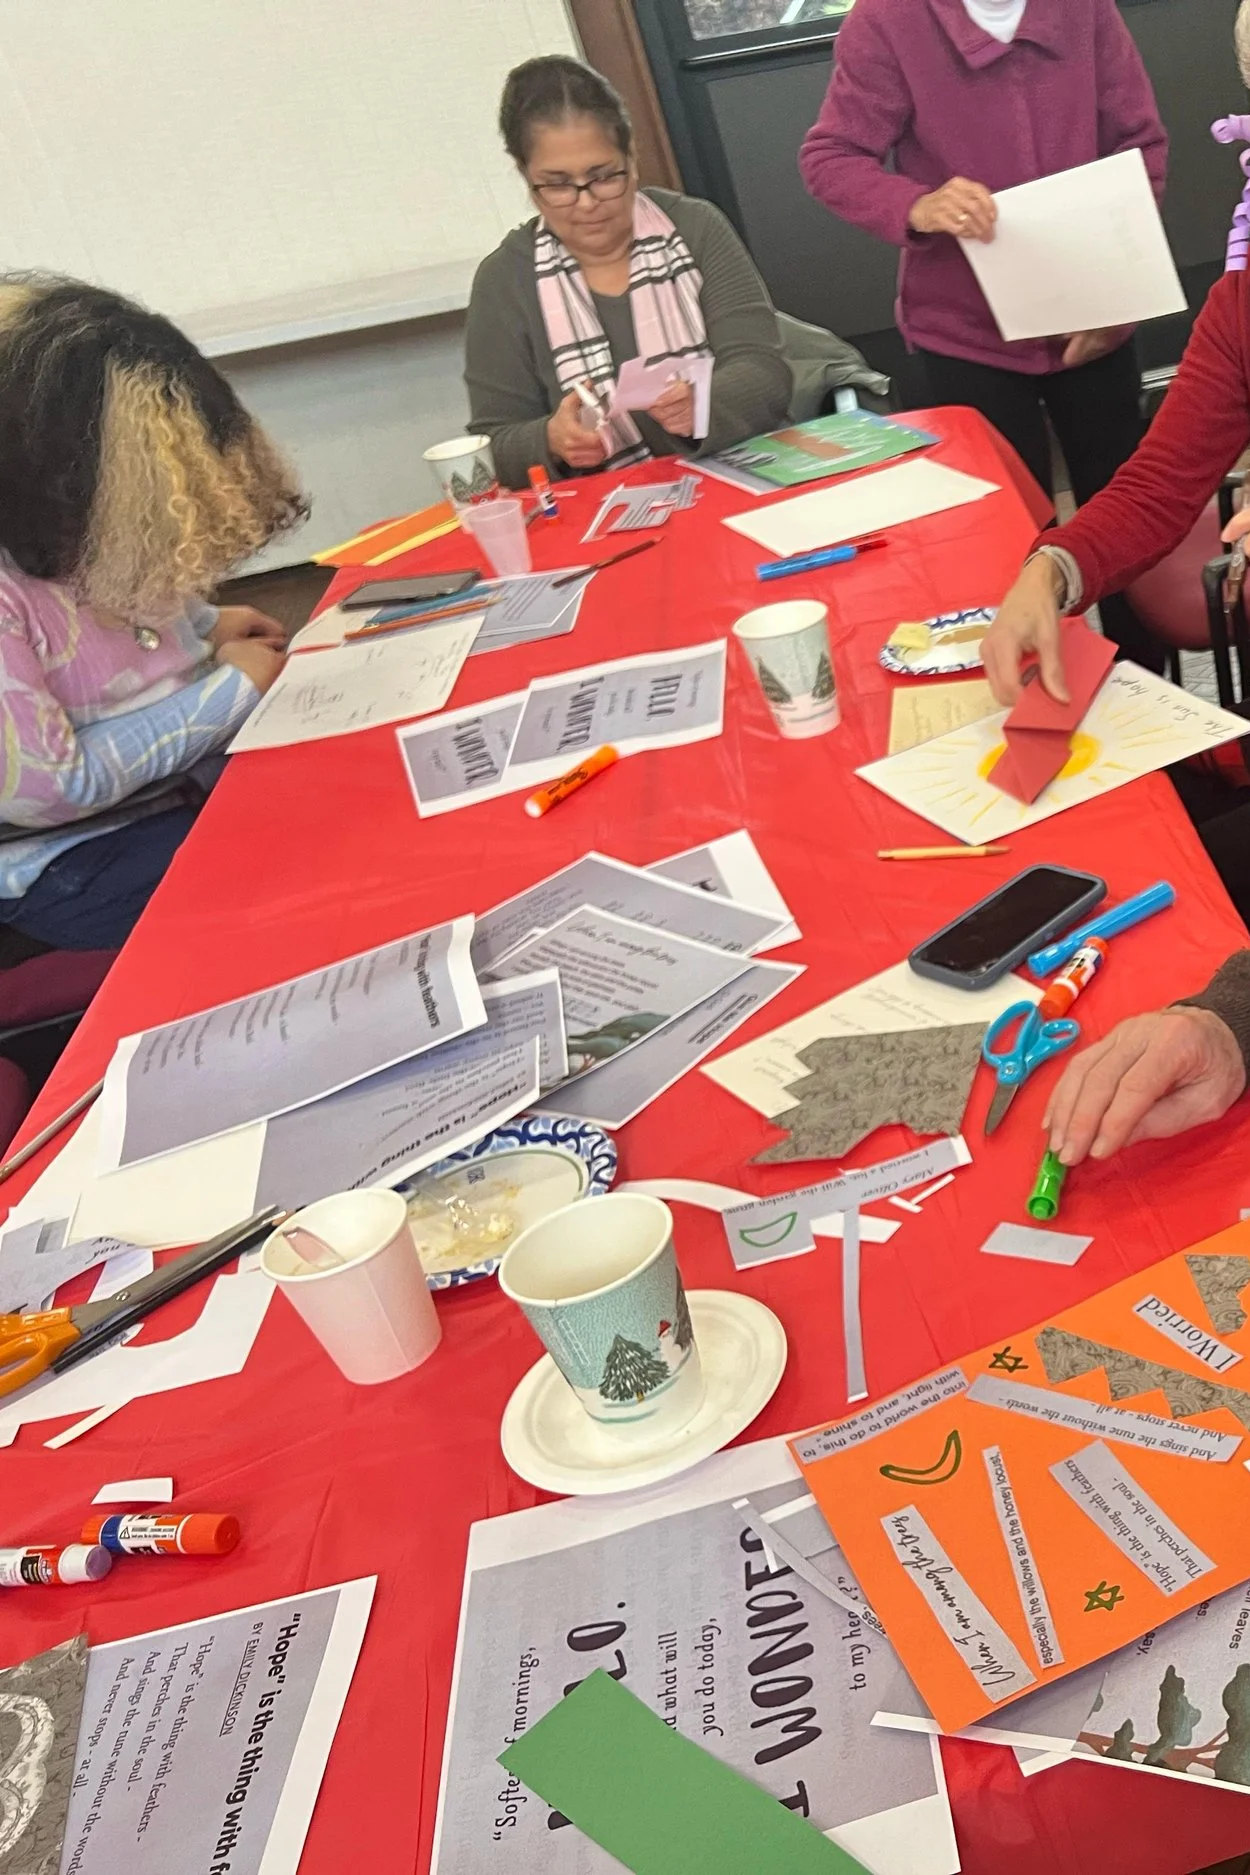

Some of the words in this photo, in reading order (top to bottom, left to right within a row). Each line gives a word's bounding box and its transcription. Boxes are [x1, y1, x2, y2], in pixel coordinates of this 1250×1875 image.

[1109, 676, 1149, 698] hope
[902, 1166, 938, 1185] Mary
[860, 1181, 899, 1199] Oliver
[1135, 1297, 1219, 1363] Worried
[1214, 1353, 1237, 1370] I
[934, 1370, 960, 1386] with
[942, 1380, 966, 1396] into
[876, 1398, 899, 1416] and
[920, 1393, 941, 1407] the
[860, 1411, 875, 1422] to
[868, 1422, 883, 1432] to
[883, 1404, 919, 1427] world
[1061, 1414, 1106, 1432] without
[849, 1429, 866, 1441] do
[1137, 1434, 1158, 1447] the
[1158, 1438, 1189, 1453] sings
[1189, 1447, 1218, 1461] And
[1064, 1459, 1096, 1495] feathers
[999, 1486, 1017, 1519] honey
[1089, 1492, 1111, 1514] with
[1111, 1481, 1136, 1501] soul
[1131, 1499, 1148, 1516] the
[891, 1515, 920, 1548] trees
[1008, 1518, 1022, 1537] the
[1107, 1510, 1132, 1537] thing
[1144, 1514, 1157, 1528] in
[1011, 1536, 1027, 1557] and
[1128, 1535, 1145, 1552] the
[1153, 1524, 1189, 1557] perches
[901, 1545, 935, 1571] the
[1140, 1550, 1152, 1561] is
[1180, 1554, 1203, 1579] That
[925, 1566, 957, 1608] among
[1019, 1558, 1037, 1597] willows
[1143, 1562, 1177, 1593] “Hope”
[1028, 1597, 1042, 1616] the
[251, 1621, 264, 1635] BY
[955, 1609, 971, 1630] am
[267, 1613, 302, 1684] “Hope”
[657, 1630, 678, 1664] will
[693, 1618, 722, 1671] today,
[952, 1629, 986, 1646] I
[1031, 1616, 1054, 1665] especially
[141, 1651, 162, 1676] And
[166, 1641, 189, 1673] That
[190, 1635, 216, 1679] “Hope”
[240, 1639, 260, 1669] EMILY
[849, 1643, 872, 1668] my
[970, 1641, 1016, 1686] When
[115, 1657, 135, 1682] And
[848, 1672, 867, 1691] to
[101, 1683, 122, 1714] never
[127, 1677, 150, 1706] sings
[151, 1674, 174, 1718] perches
[184, 1682, 199, 1693] is
[513, 1647, 540, 1731] mornings,
[656, 1666, 677, 1712] what
[694, 1676, 715, 1697] do
[177, 1694, 194, 1715] the
[219, 1669, 251, 1738] DICKINSON
[258, 1690, 282, 1709] is
[122, 1708, 139, 1728] the
[145, 1719, 158, 1733] in
[247, 1711, 274, 1744] the
[702, 1701, 724, 1737] you
[110, 1729, 129, 1758] tune
[137, 1735, 156, 1756] the
[161, 1716, 188, 1751] thing
[127, 1757, 144, 1783] soul
[154, 1751, 173, 1781] with
[225, 1746, 264, 1805] thing
[90, 1759, 118, 1810] without
[136, 1782, 167, 1834] feathers
[82, 1812, 102, 1833] the
[212, 1807, 243, 1860] with
